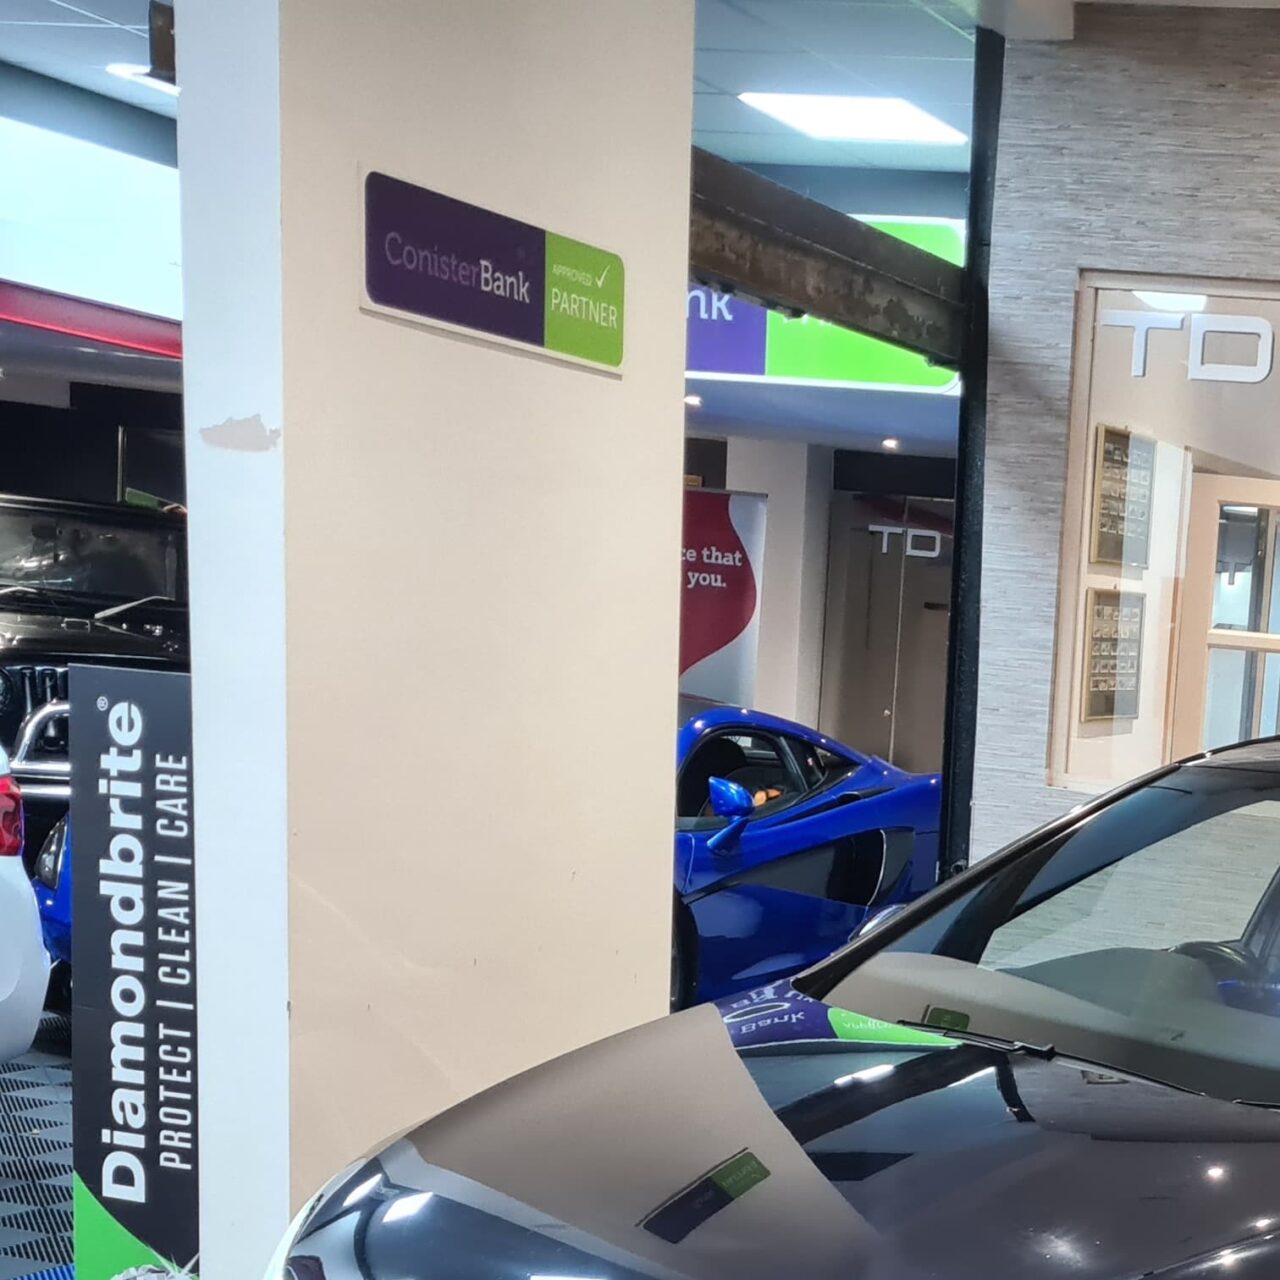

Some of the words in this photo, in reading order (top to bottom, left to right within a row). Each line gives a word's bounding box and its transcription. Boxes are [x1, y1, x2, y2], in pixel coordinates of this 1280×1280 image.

[385, 231, 531, 304] ConisterBank
[551, 287, 618, 329] PARTNER
[1100, 309, 1275, 383] TD
[701, 546, 743, 567] that
[868, 524, 941, 558] TD
[687, 571, 727, 589] you.
[155, 753, 188, 838] CARE
[157, 880, 192, 986] CLEAN
[159, 1022, 193, 1171] PROTECT
